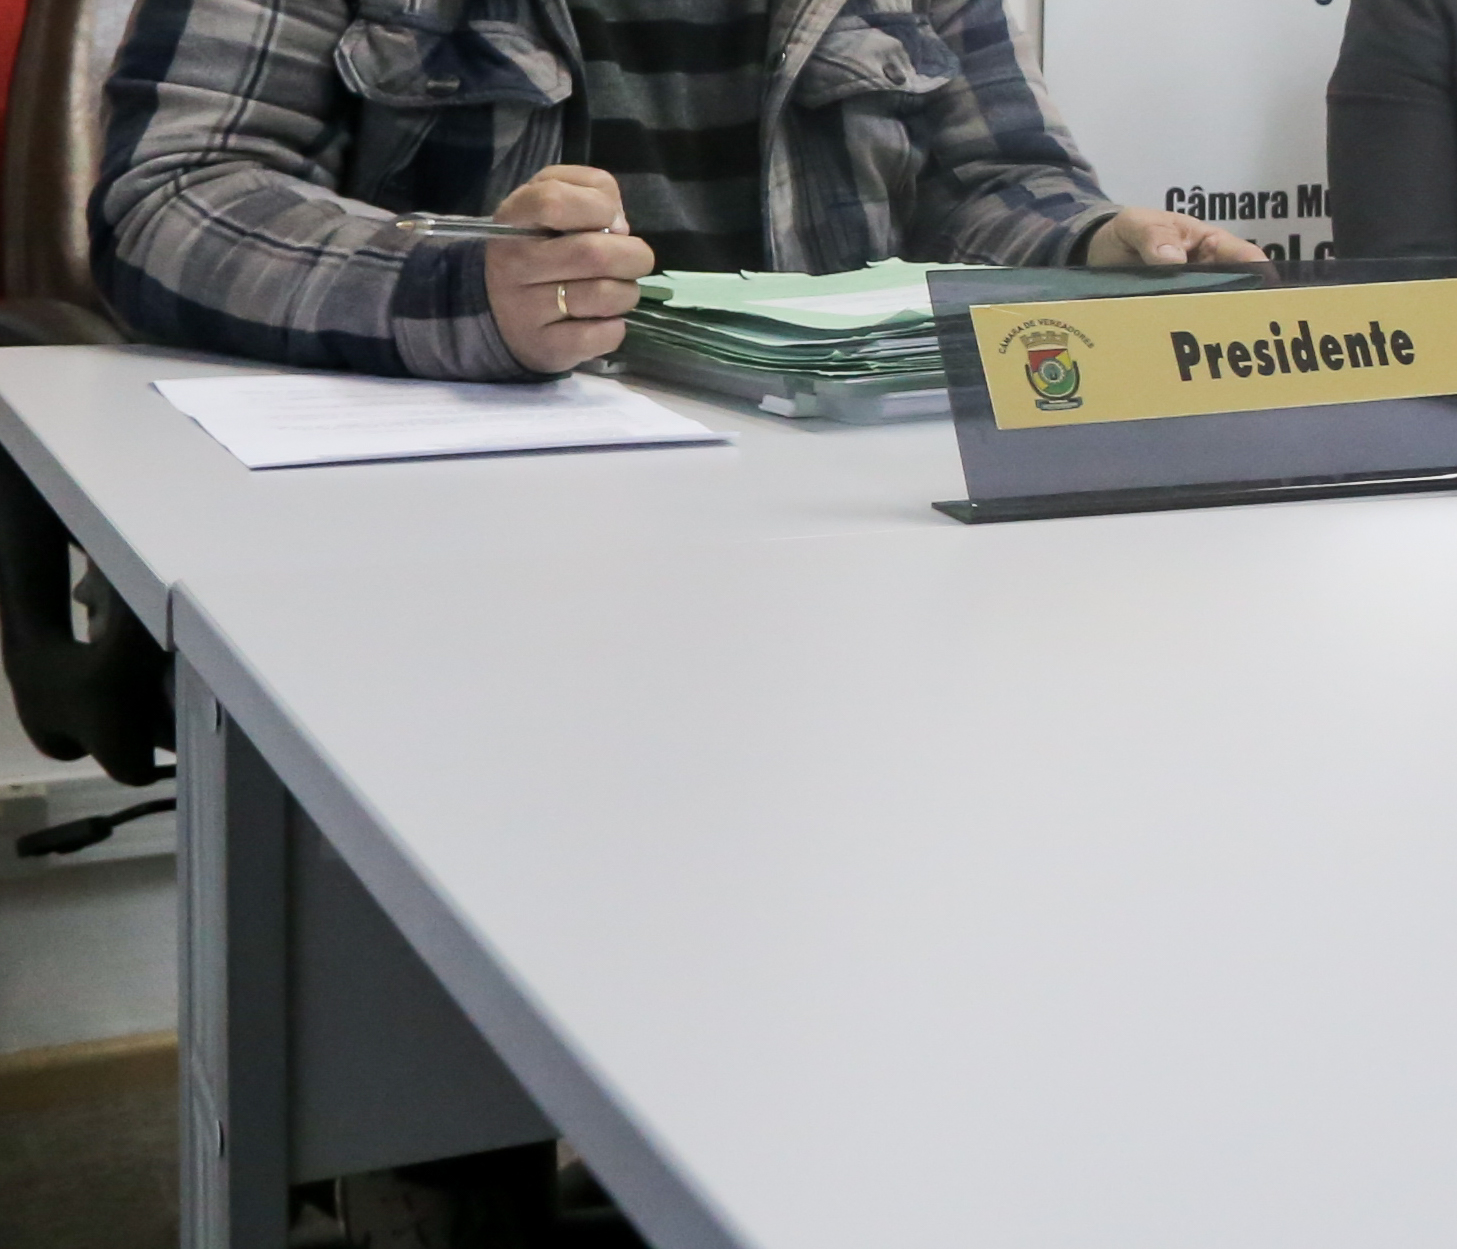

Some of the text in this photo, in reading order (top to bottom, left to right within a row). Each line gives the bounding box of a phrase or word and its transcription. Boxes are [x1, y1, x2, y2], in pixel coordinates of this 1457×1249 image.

[1165, 184, 1289, 221] Câmara
[1023, 319, 1037, 330] DE
[1037, 318, 1095, 350] VEREADORES
[1170, 320, 1416, 382] Presidente
